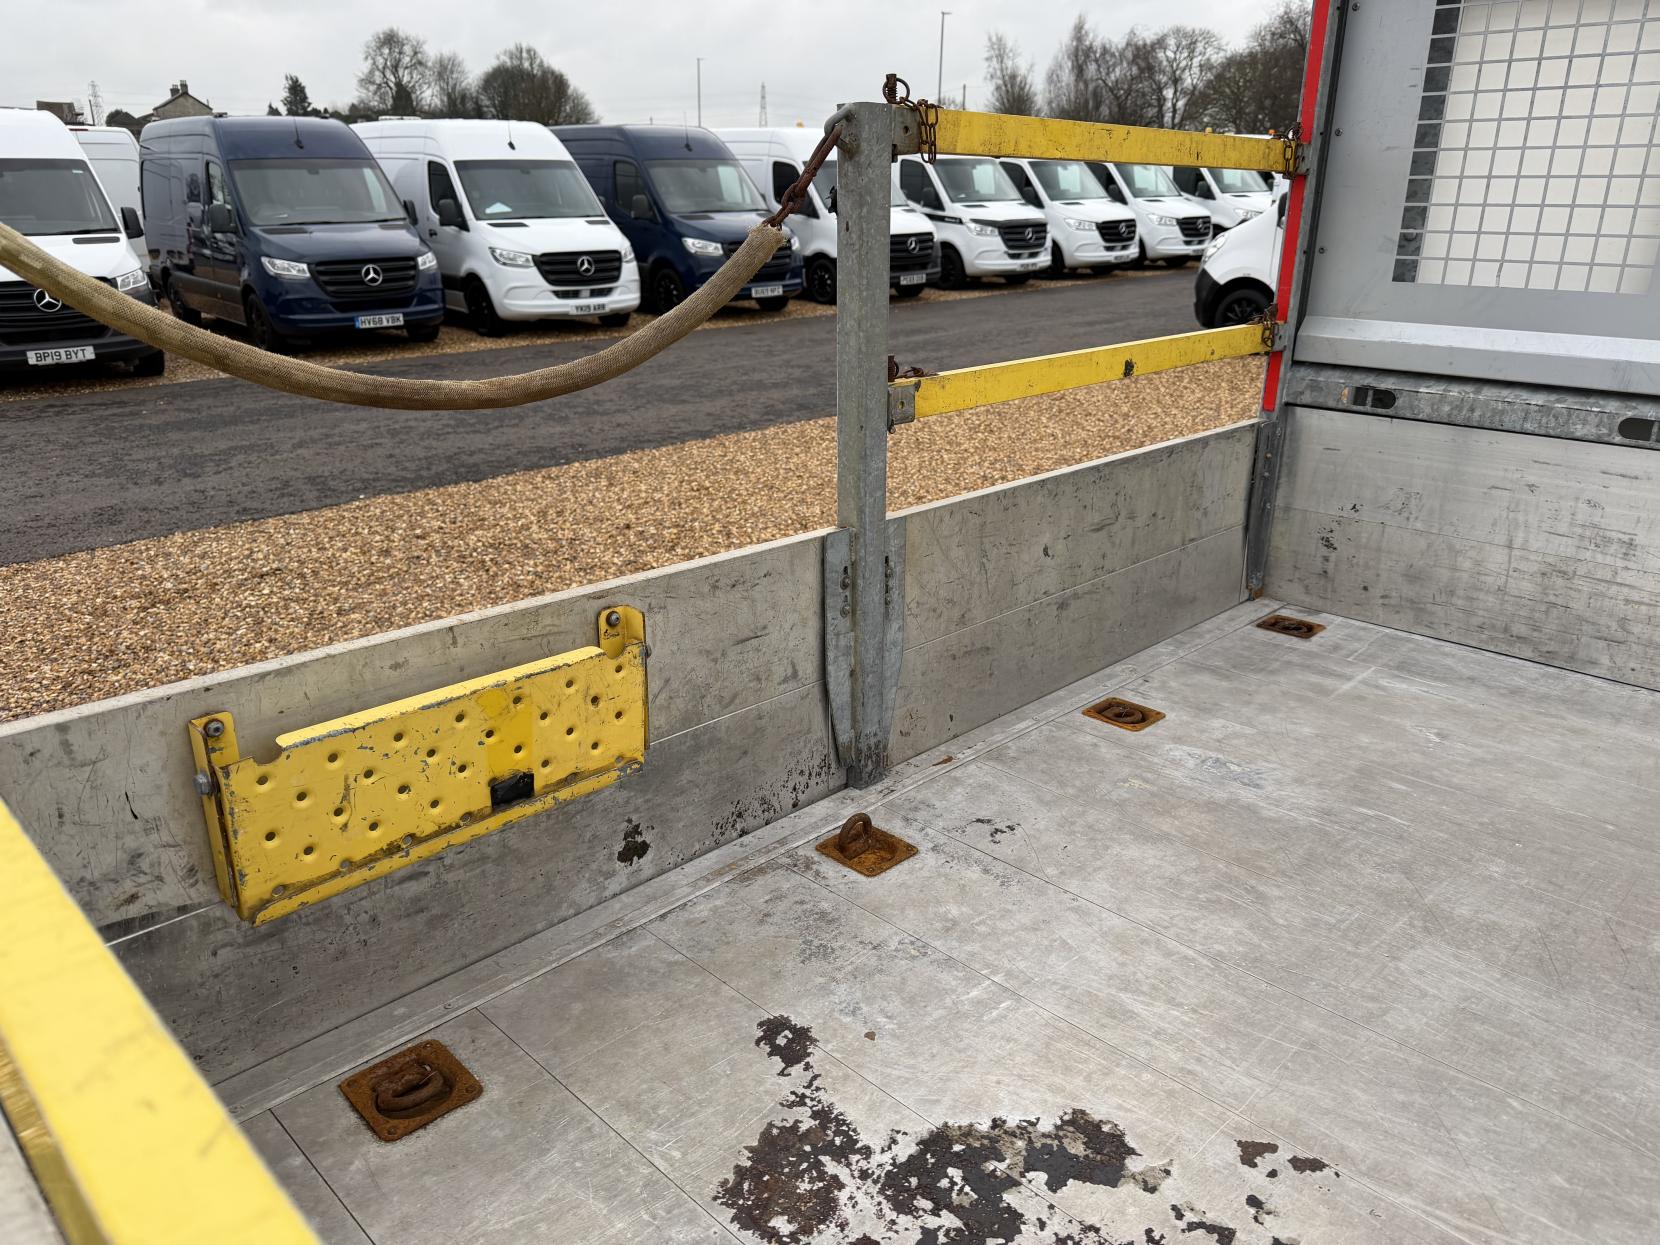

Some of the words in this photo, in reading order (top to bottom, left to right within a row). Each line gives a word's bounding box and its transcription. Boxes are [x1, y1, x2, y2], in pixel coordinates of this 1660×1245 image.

[360, 316, 383, 326] HV68
[385, 314, 401, 324] VBK
[34, 350, 62, 362] BP19
[64, 348, 87, 360] BYT
